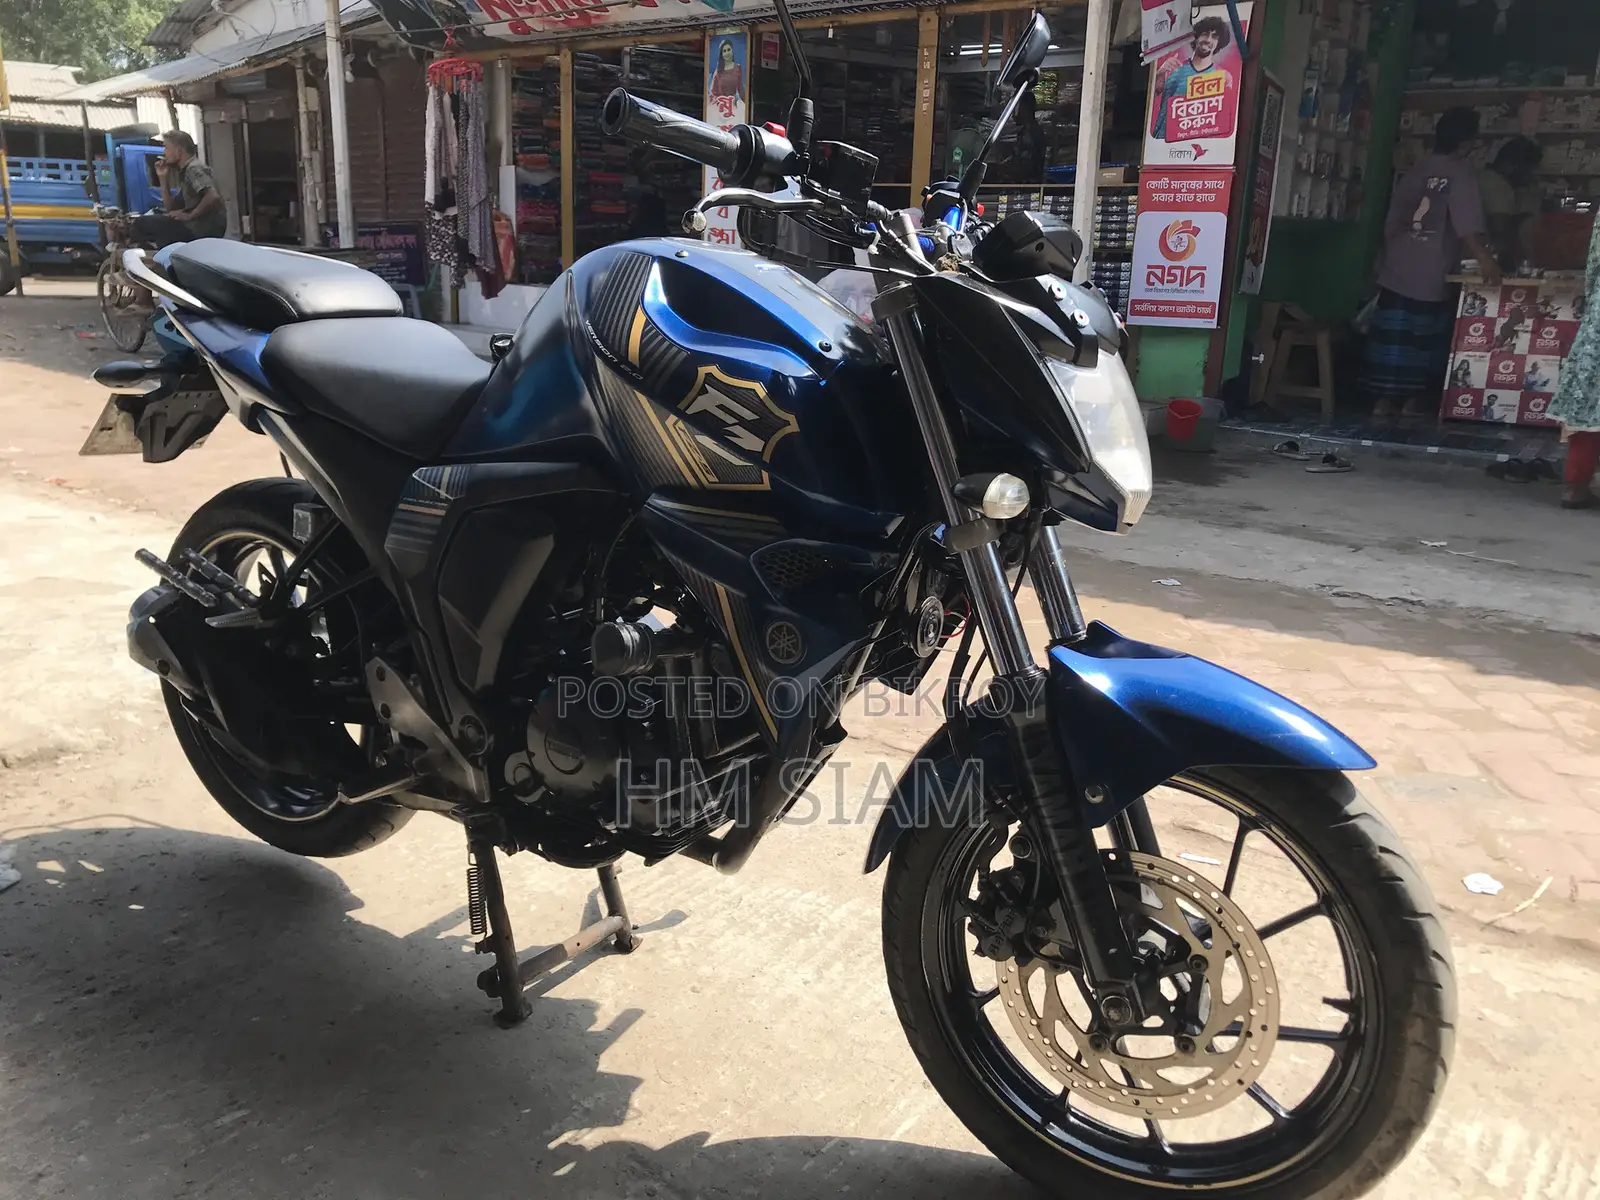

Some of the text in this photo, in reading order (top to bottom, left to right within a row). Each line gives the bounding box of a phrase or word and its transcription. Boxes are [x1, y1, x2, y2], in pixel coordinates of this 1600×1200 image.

[1189, 76, 1223, 97] বিল
[1171, 95, 1224, 119] বিকাশ
[1179, 111, 1217, 130] করুন
[1169, 148, 1192, 159] বিকাশ
[1146, 177, 1225, 193] কোটি মানুষের সাথে
[1152, 193, 1216, 203] সবার হাতে হাতে
[1146, 264, 1207, 288] নগদ
[1176, 304, 1196, 314] আউট
[585, 319, 645, 381] VERSION 2.0
